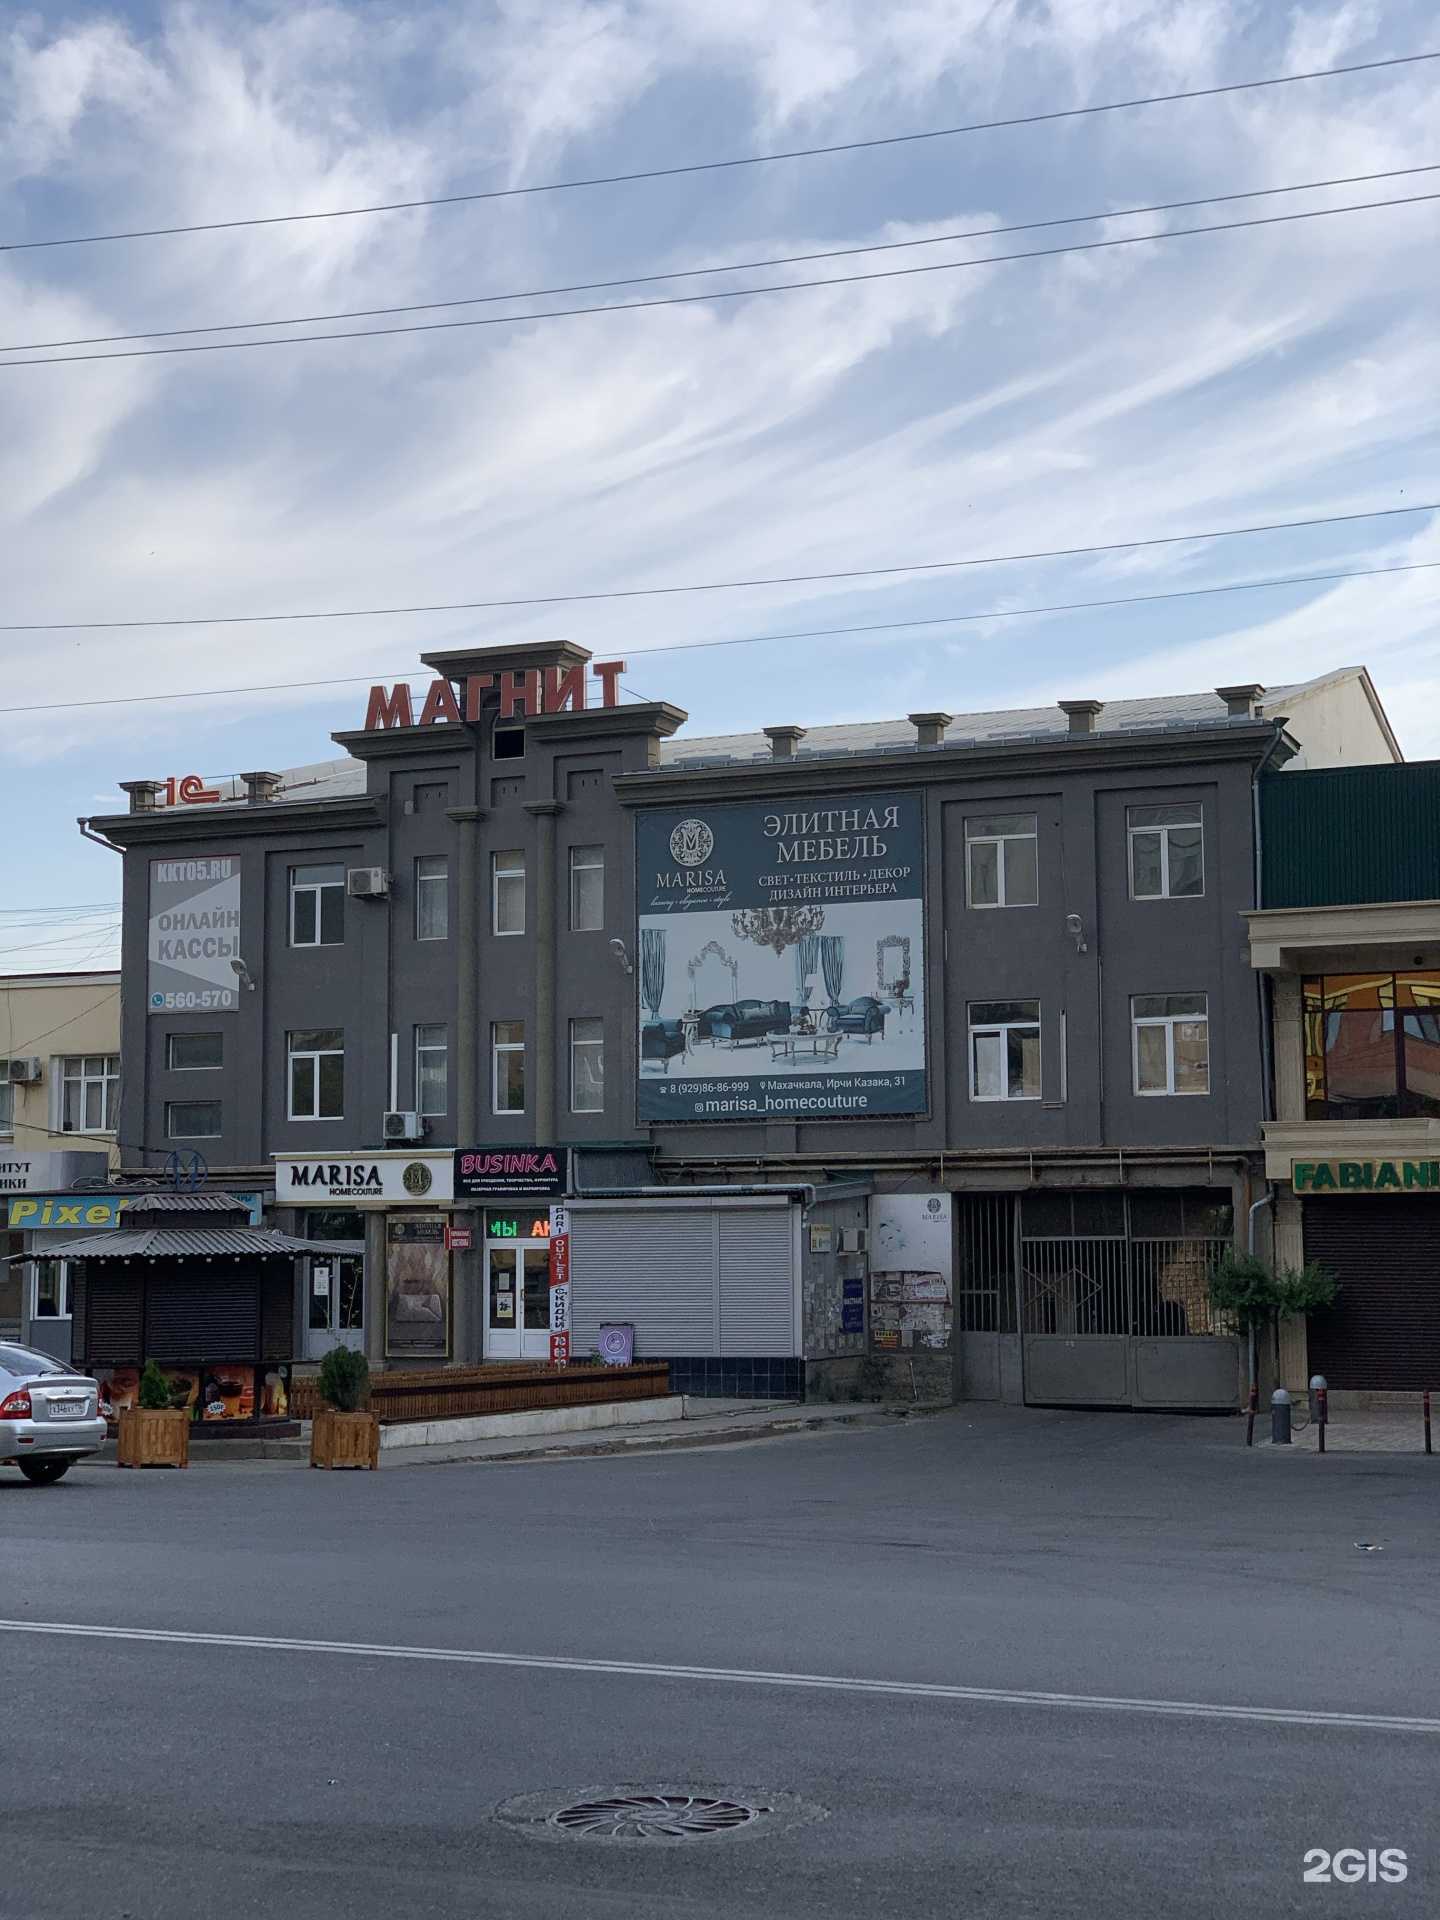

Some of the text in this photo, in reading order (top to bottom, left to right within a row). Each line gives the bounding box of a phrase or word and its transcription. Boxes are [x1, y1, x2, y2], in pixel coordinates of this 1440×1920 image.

[364, 661, 626, 730] МАГНИТ
[763, 806, 899, 837] ЭЛИТНАЯ
[776, 835, 887, 864] МЕБЕЛЬ
[656, 870, 727, 888] MARISA
[758, 866, 911, 887] СВЕТ ТЕКСТИЛЬ ДЕКОР
[769, 882, 897, 902] ДИЗАЙН ИНТЕРЬЕРА
[158, 906, 239, 931] ОНЛАЙН
[158, 935, 238, 960] КАССЫ
[164, 990, 232, 1008] 560-570
[670, 1083, 676, 1093] 8
[767, 1079, 825, 1090] Махачкала,
[826, 1078, 852, 1090] Ирчи
[894, 1076, 905, 1086] 31
[706, 1094, 868, 1112] marisa_homecouture
[461, 1153, 557, 1174] BUSINKA
[291, 1165, 383, 1186] MARISA
[329, 1187, 383, 1195] HOMECOUTURE
